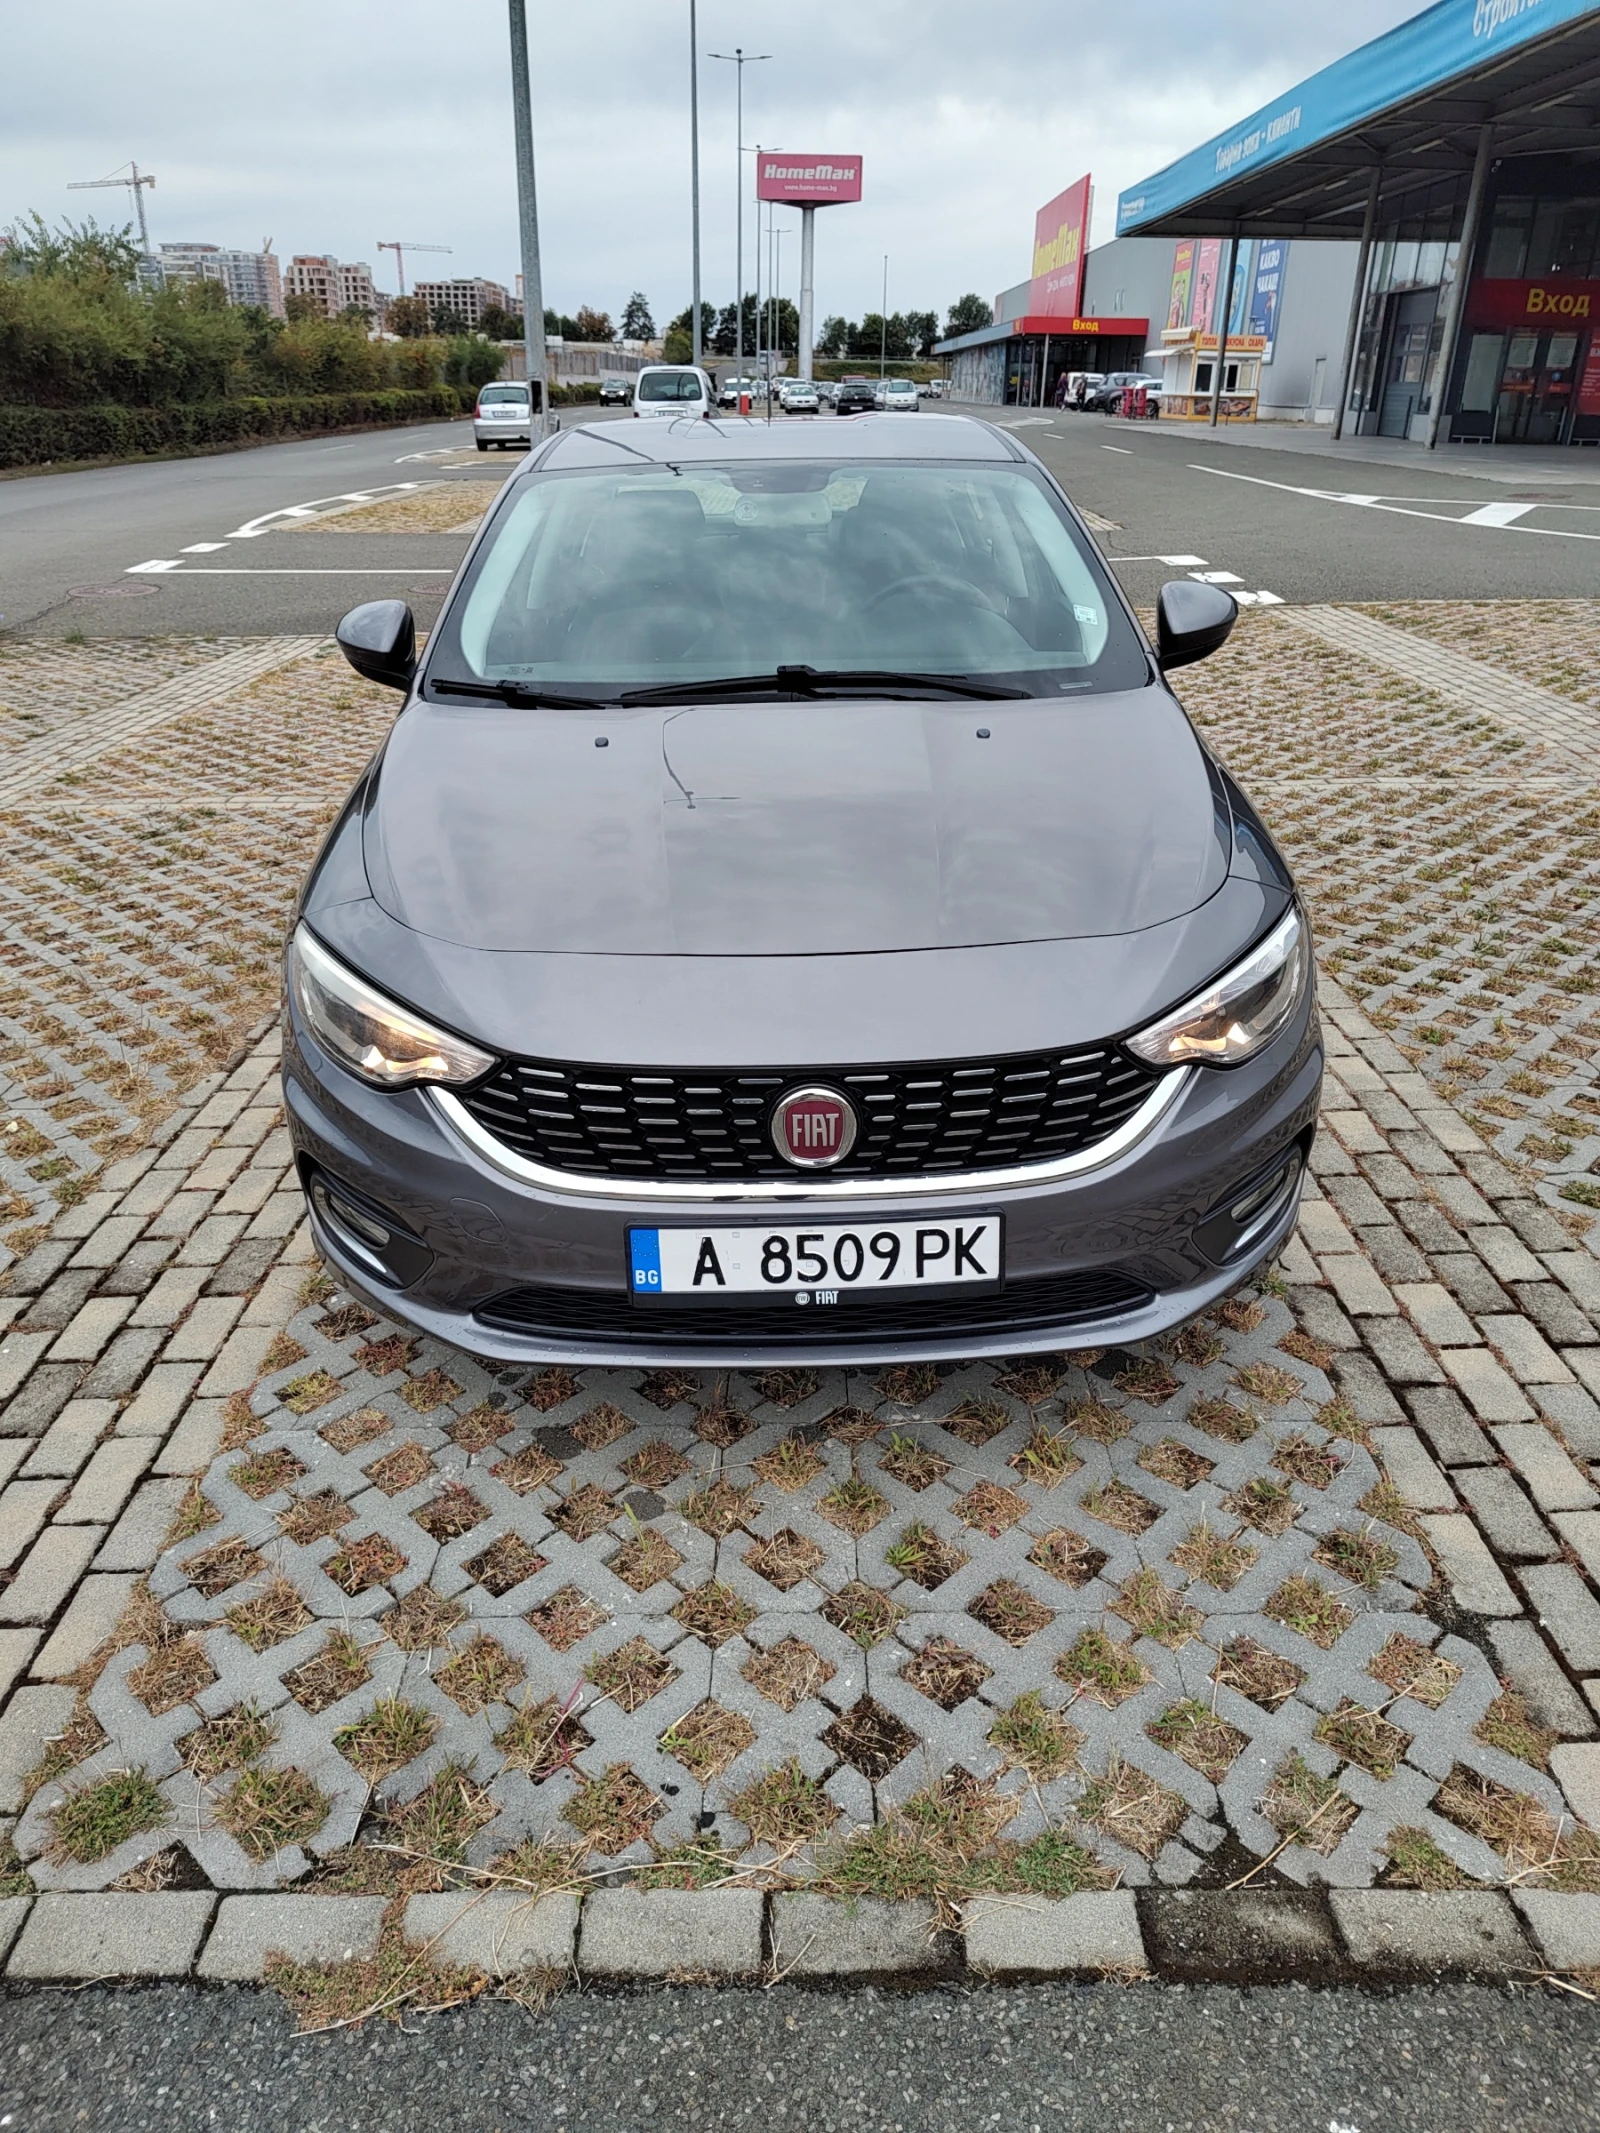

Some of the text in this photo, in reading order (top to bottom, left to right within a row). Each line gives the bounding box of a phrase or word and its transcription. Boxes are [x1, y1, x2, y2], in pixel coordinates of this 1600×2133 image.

[764, 164, 855, 180] HomeMax
[1526, 288, 1590, 317] Вход
[1072, 319, 1099, 332] Вход
[792, 1113, 840, 1147] FIAT
[692, 1225, 988, 1286] A 8509 PK
[635, 1270, 659, 1285] BG
[815, 1291, 839, 1305] FIAT
